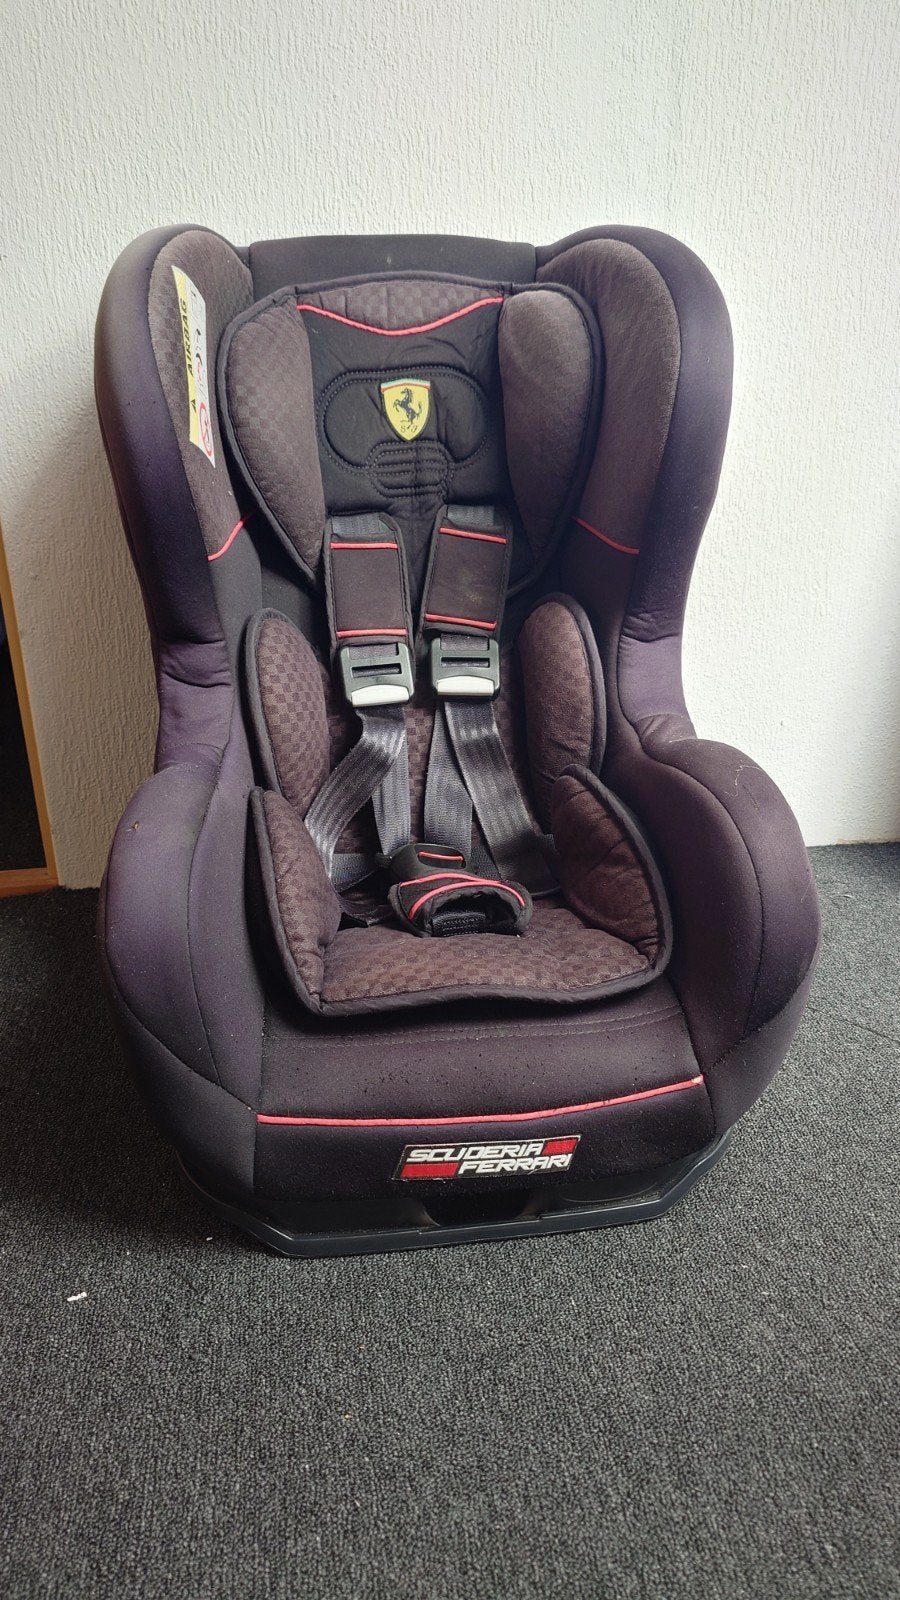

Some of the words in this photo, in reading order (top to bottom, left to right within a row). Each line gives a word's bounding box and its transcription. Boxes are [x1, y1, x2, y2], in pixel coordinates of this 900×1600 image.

[180, 299, 194, 377] AIRBAG
[406, 1142, 545, 1162] SCUDERIA
[457, 1153, 573, 1175] FERRARI
